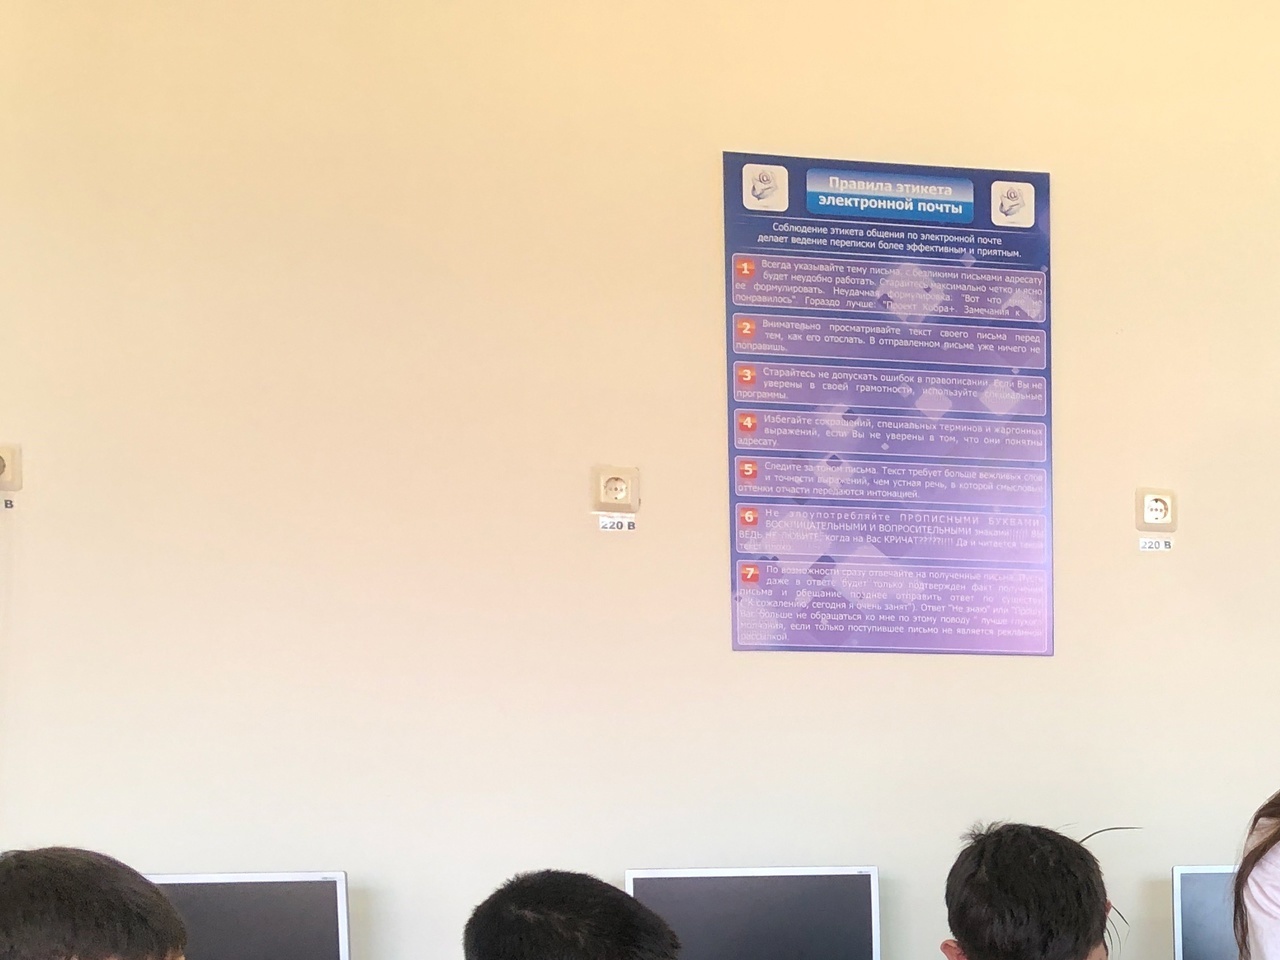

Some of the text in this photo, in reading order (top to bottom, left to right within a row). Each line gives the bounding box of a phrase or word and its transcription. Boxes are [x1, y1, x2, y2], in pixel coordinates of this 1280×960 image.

[829, 177, 952, 195] Правила этикета
[818, 196, 962, 213] электронной почты
[772, 223, 827, 234] Соблюдение
[866, 229, 904, 239] общения
[920, 234, 973, 243] электронной
[791, 238, 827, 246] ведение
[830, 240, 875, 248] переписки
[878, 241, 903, 250] более
[906, 243, 966, 253] эффективным
[977, 249, 1021, 257] приятным.
[761, 260, 1042, 285] Всегда указывайте тему письмами адресату
[763, 271, 788, 282] будет
[791, 274, 832, 283] неудобно
[835, 276, 875, 285] работать.
[931, 283, 986, 291] максимально
[753, 282, 824, 294] формулировать.
[833, 287, 879, 297] Неудачная
[805, 296, 1009, 315] Гораздо Замечания
[742, 322, 750, 333] 2
[762, 320, 820, 330] Внимательно
[829, 325, 900, 335] просматривайте
[1015, 335, 1039, 343] перед
[879, 339, 939, 347] отправленном
[742, 370, 751, 380] 3
[763, 368, 815, 378] Старайтесь
[832, 373, 877, 382] допускать
[880, 374, 914, 383] ошибок
[763, 381, 802, 390] уверены
[822, 383, 848, 391] своей
[856, 386, 915, 395] грамотности,
[742, 417, 752, 427] 4
[764, 415, 812, 424] Избегайте
[877, 422, 936, 430] специальных
[939, 425, 982, 433] терминов
[852, 430, 864, 438] Вы
[886, 433, 924, 442] уверены
[744, 464, 752, 474] 5
[764, 462, 975, 478] Следите Текст требует больше
[892, 480, 920, 488] устная
[924, 481, 947, 489] речь,
[959, 482, 993, 491] которой
[812, 488, 863, 496] передаются
[744, 511, 753, 521] 6
[765, 509, 978, 524] Не ПРОПИСНЫМИ
[601, 521, 623, 530] 220
[879, 524, 971, 535] ВОПРОСИТЕЛЬНЫМИ
[1141, 541, 1160, 549] 220
[745, 568, 754, 579] 7
[810, 611, 861, 621] обращаться
[848, 625, 904, 633] поступившее
